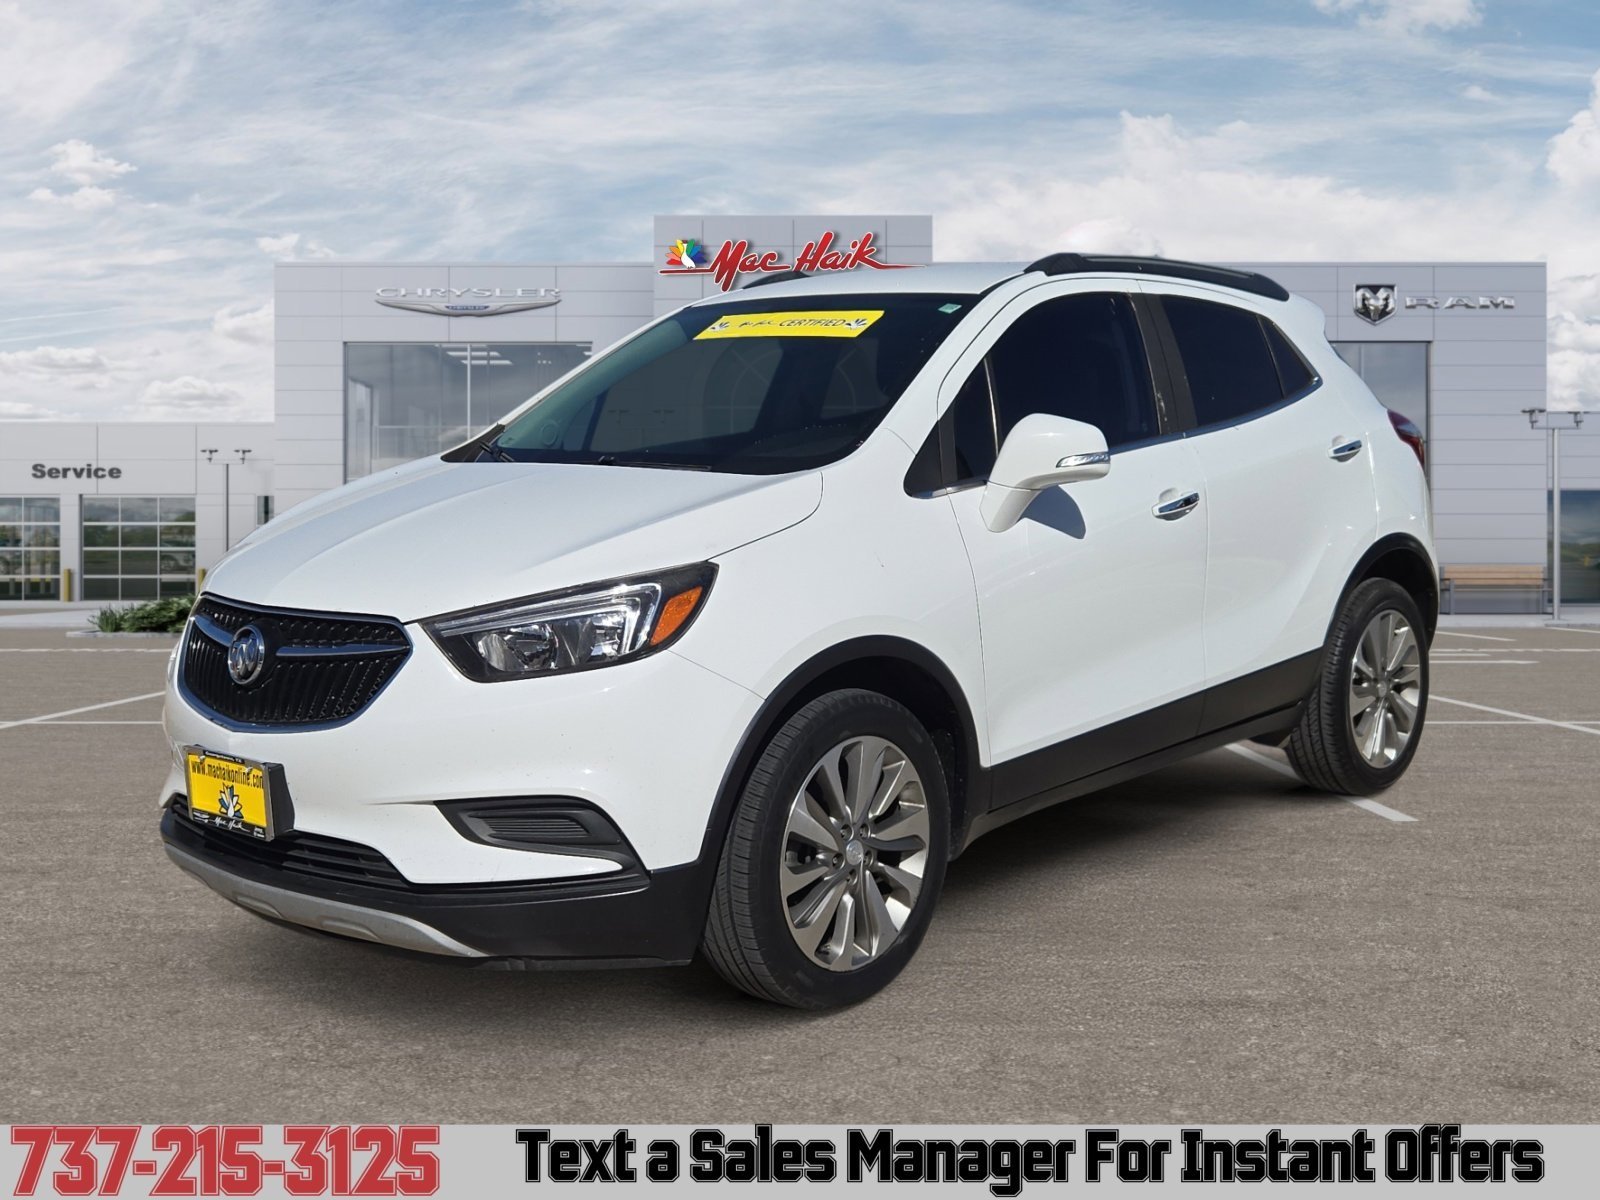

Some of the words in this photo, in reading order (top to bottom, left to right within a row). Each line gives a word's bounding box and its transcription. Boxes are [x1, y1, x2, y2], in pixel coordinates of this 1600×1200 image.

[709, 239, 790, 292] Mac
[793, 231, 880, 272] Haik
[375, 287, 562, 298] CHRYSLER
[1405, 297, 1515, 310] RAM
[778, 318, 847, 327] CERTIFIED
[31, 463, 122, 479] Service
